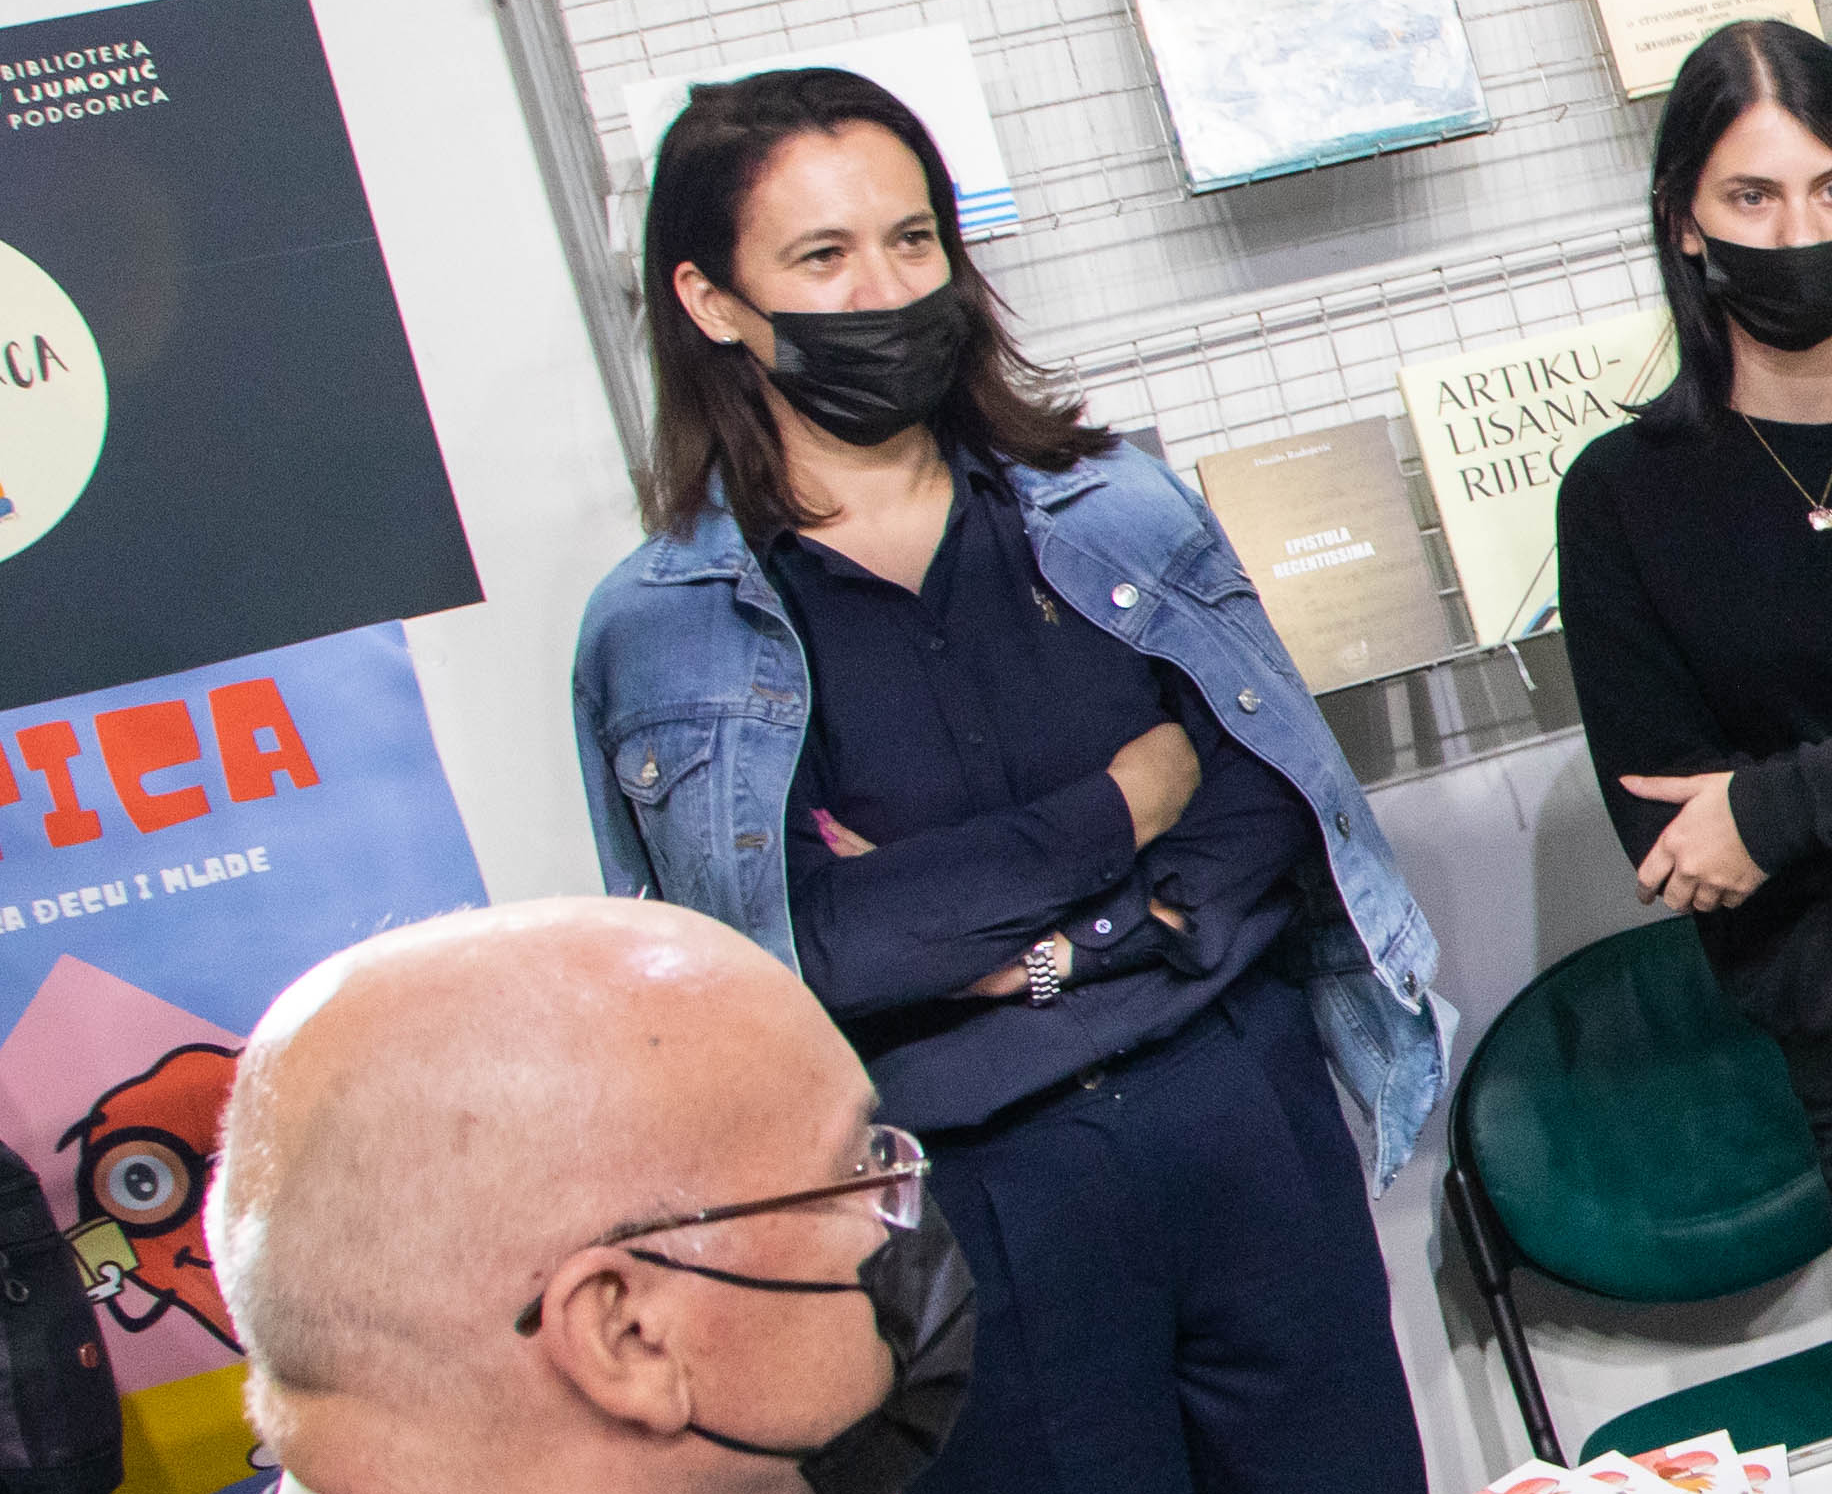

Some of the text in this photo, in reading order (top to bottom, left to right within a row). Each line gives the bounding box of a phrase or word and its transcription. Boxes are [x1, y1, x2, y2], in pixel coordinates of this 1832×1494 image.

[1, 39, 152, 81] BIBLIOTEKA
[13, 58, 160, 105] LJUMOVIĆ
[8, 85, 170, 131] PODGORICA
[1436, 345, 1621, 417] ARTIKU-
[1445, 389, 1612, 455] LISANA
[1458, 434, 1566, 502] RIJEČ
[0, 678, 321, 861] ICA
[0, 906, 27, 935] A
[137, 874, 153, 901] I
